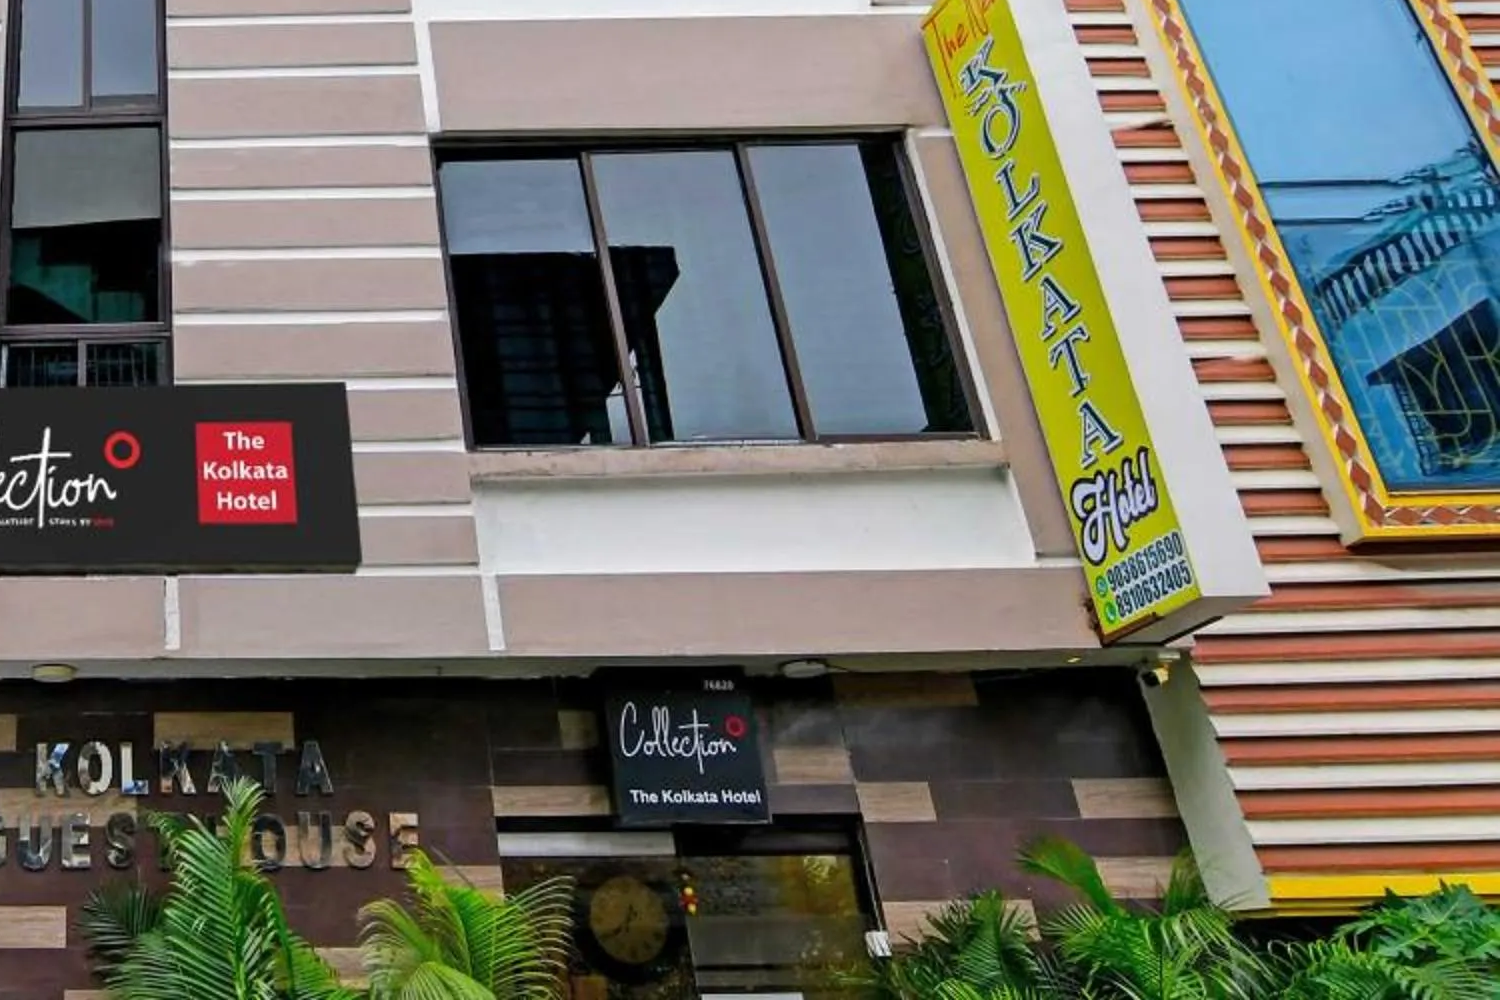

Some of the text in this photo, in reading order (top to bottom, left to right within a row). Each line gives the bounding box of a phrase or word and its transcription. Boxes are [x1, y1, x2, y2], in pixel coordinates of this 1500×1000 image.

[959, 34, 1125, 470] KOLKATA
[203, 460, 289, 481] Kolkata
[223, 431, 266, 451] The
[217, 490, 278, 511] Hotel
[1070, 446, 1159, 566] Hotel
[1107, 531, 1183, 593] 9038615690
[1115, 559, 1192, 619] 8910632405
[620, 701, 737, 774] Collection
[35, 740, 333, 796] KOLKATA
[630, 789, 762, 804] The Kolkata Hotel
[204, 810, 419, 872] OUSE
